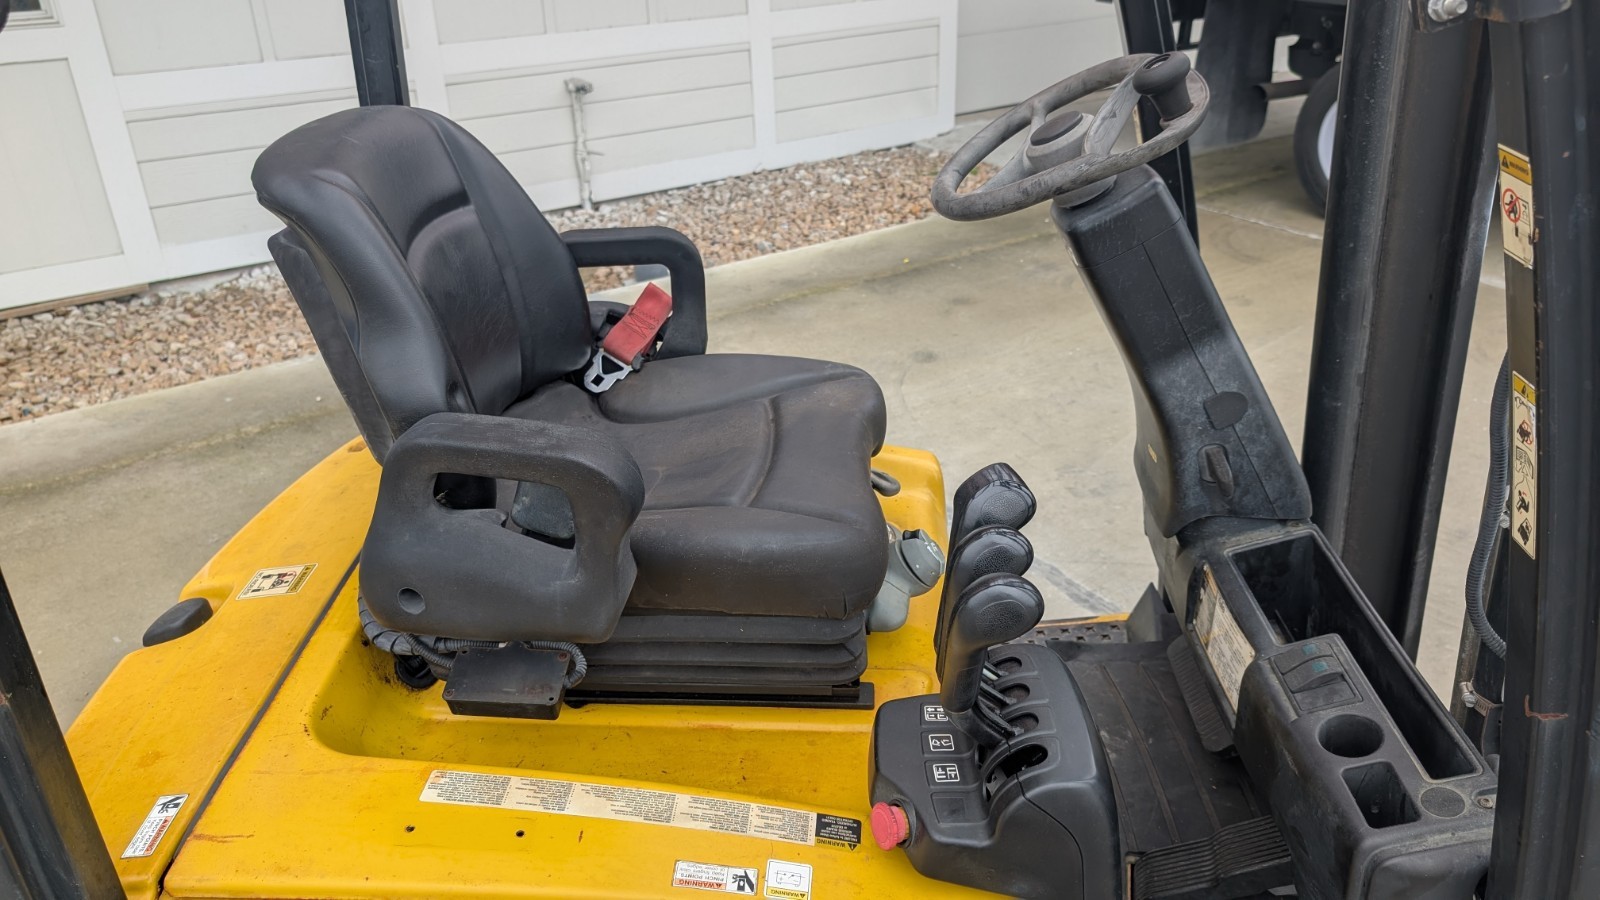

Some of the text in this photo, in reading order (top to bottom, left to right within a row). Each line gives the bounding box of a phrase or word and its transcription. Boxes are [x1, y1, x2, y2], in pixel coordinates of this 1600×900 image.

[816, 838, 846, 848] WARNING
[679, 879, 716, 888] WARNING
[770, 889, 800, 898] WARNING
